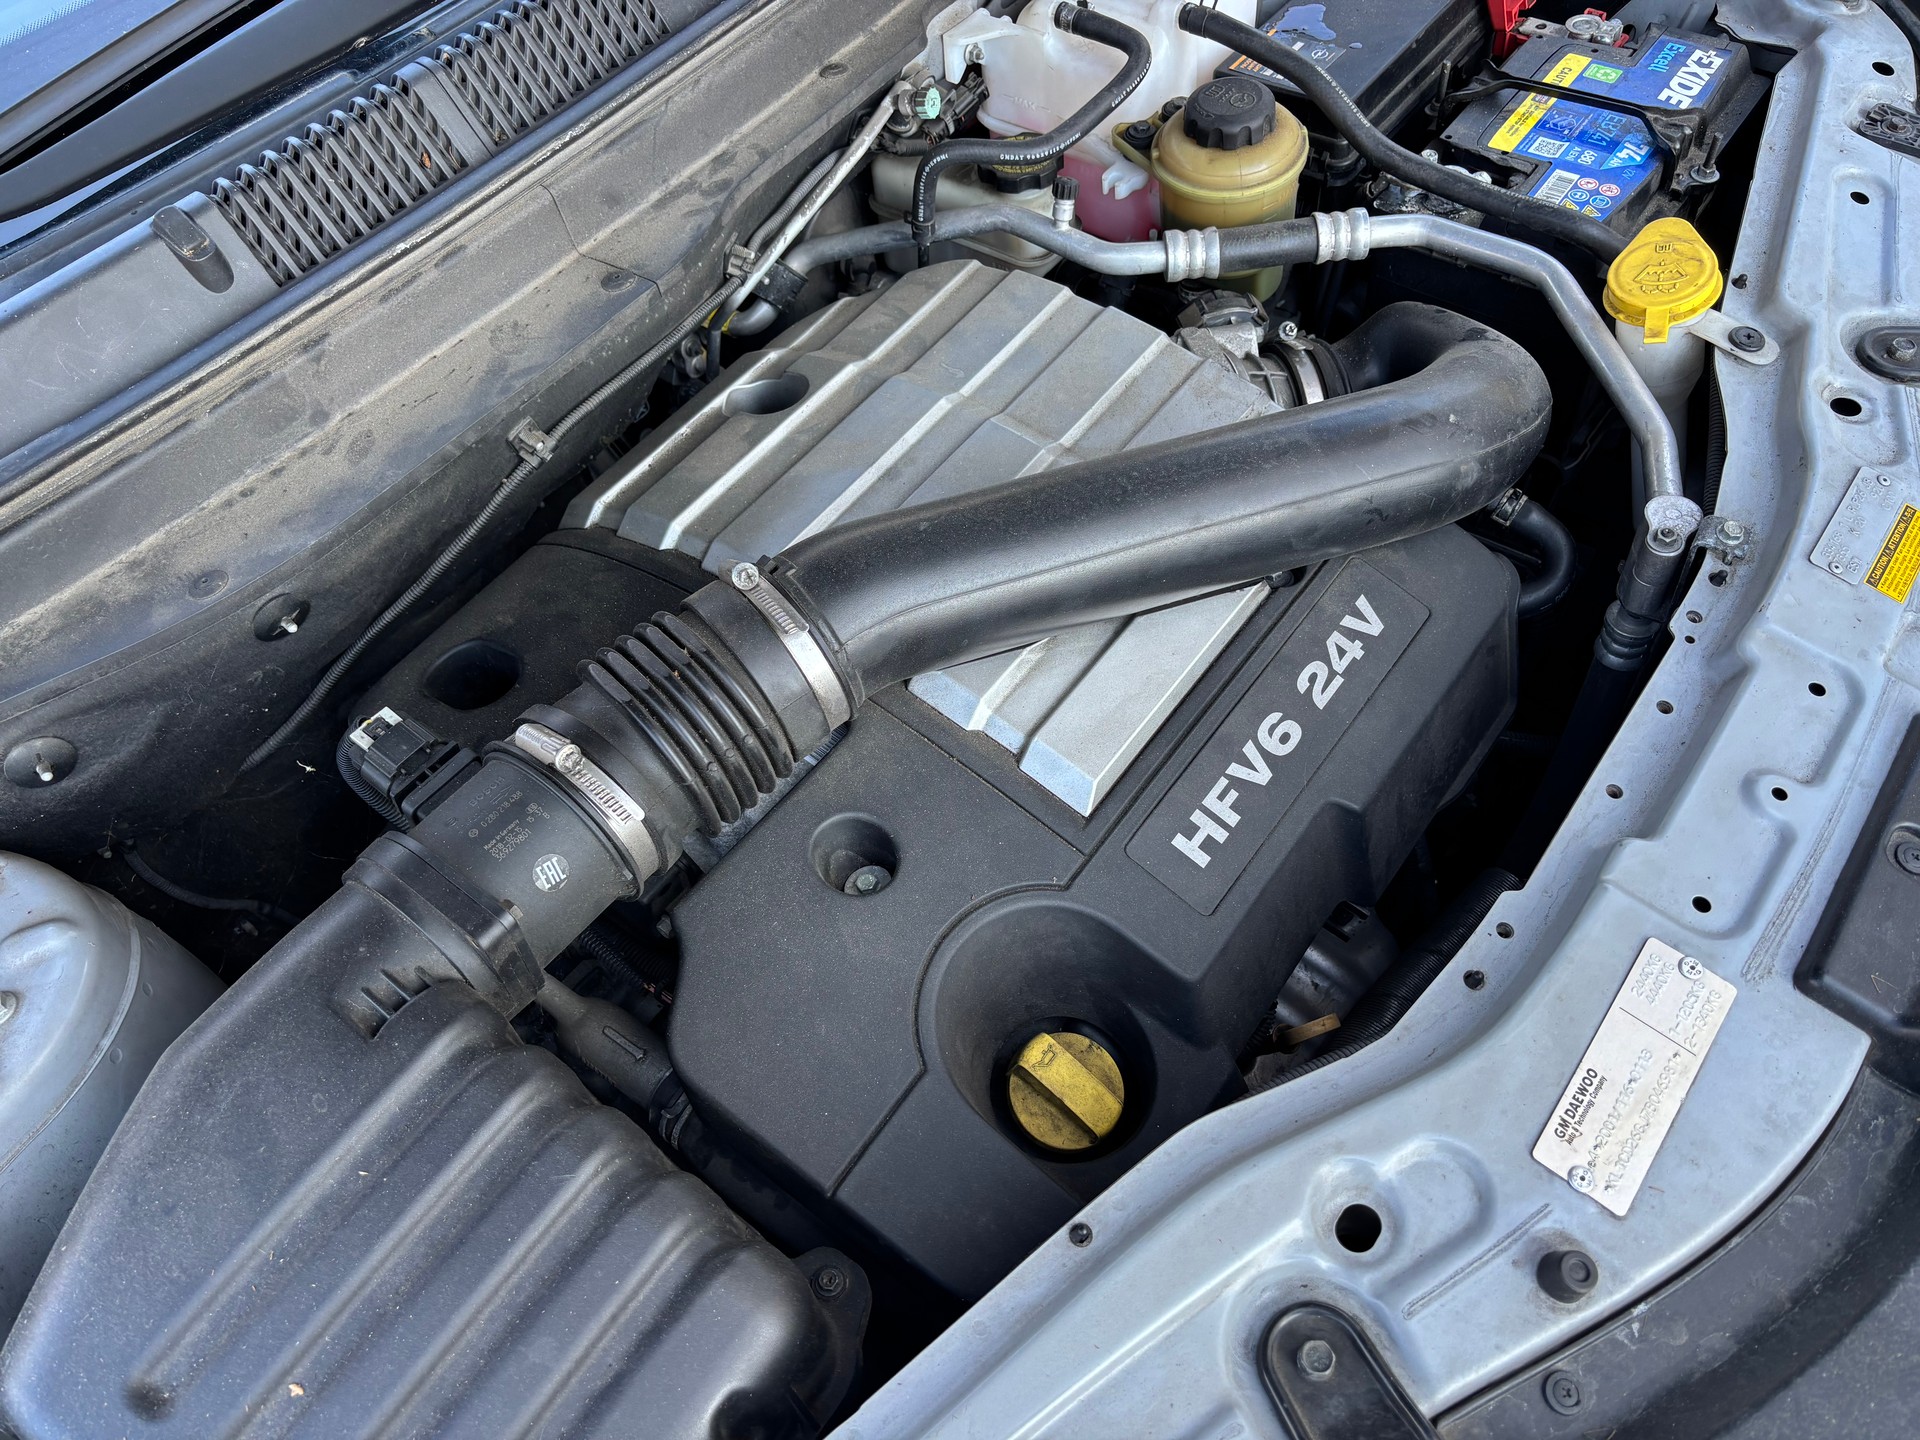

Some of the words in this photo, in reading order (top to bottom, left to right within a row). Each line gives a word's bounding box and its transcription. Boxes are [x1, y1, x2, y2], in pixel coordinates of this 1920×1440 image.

[1648, 42, 1686, 73] Excell
[1658, 49, 1725, 109] EXIDE
[1578, 149, 1597, 164] 680
[1171, 711, 1302, 868] HFV6
[1297, 594, 1384, 710] 24V
[1631, 952, 1662, 997] 2440KG
[1554, 1117, 1572, 1139] GM
[1564, 1068, 1598, 1117] DAEWOO
[1564, 1131, 1577, 1145] Auto
[1574, 1099, 1596, 1127] Technology
[1589, 1075, 1607, 1099] Company
